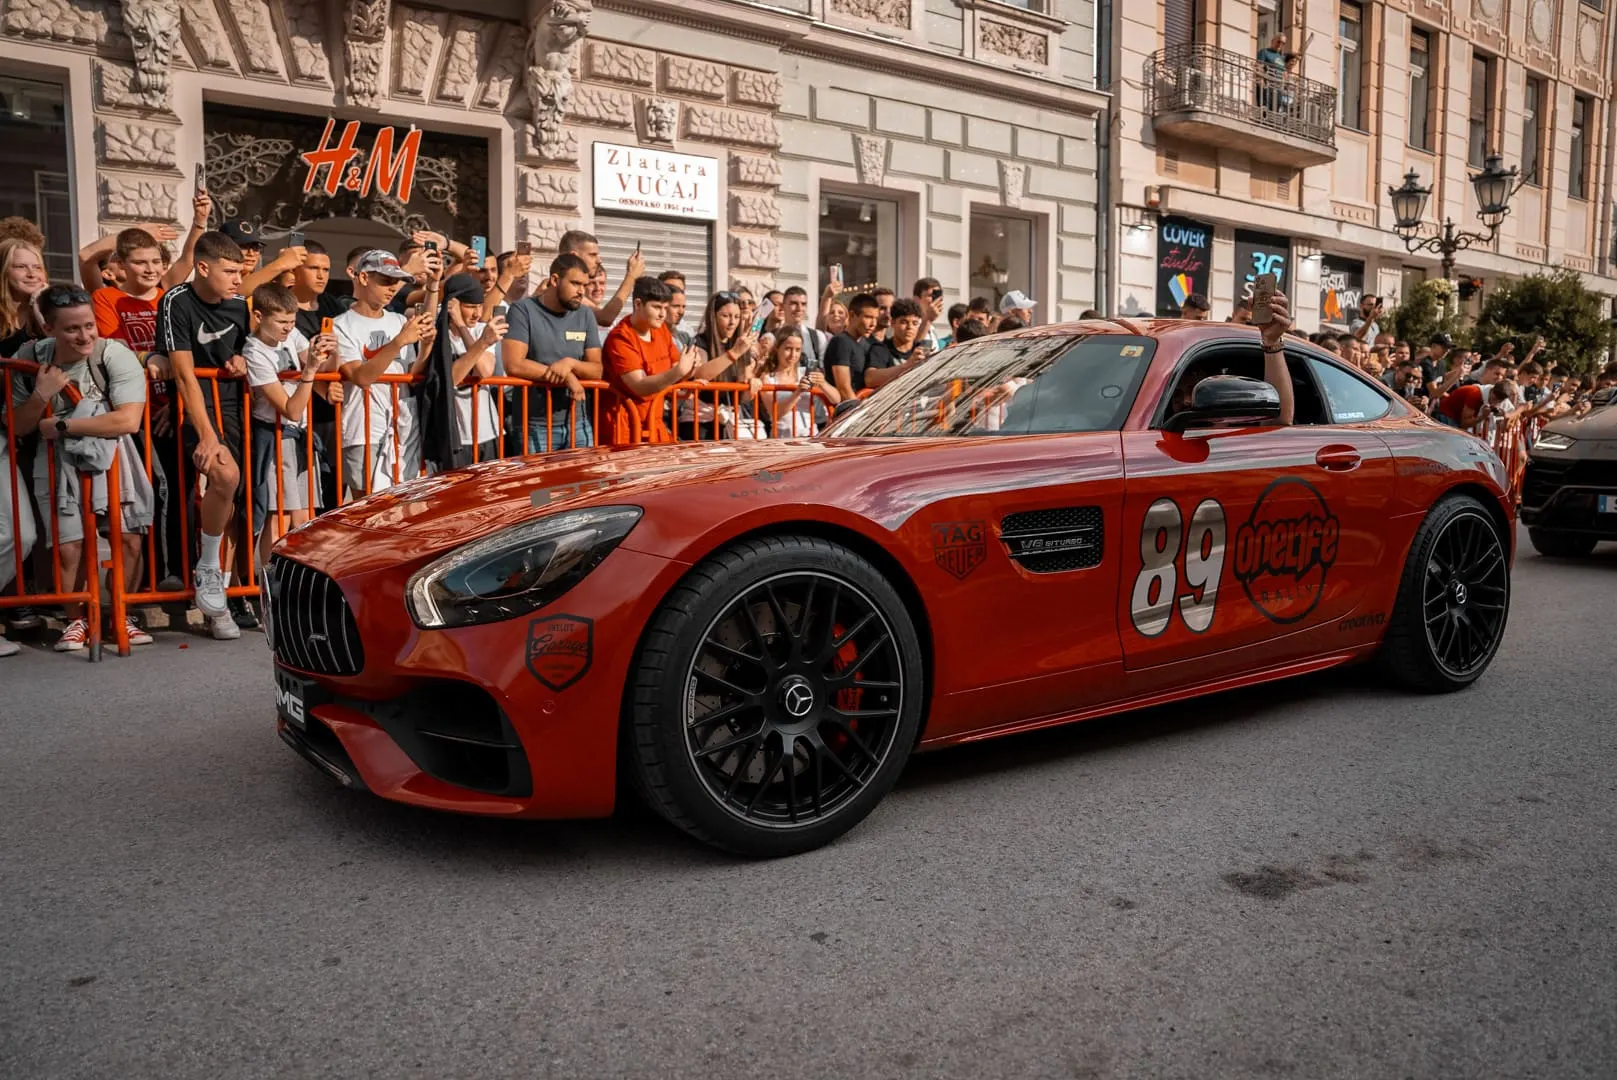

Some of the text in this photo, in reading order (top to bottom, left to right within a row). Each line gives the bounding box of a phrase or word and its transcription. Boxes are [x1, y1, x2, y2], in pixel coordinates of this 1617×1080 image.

[301, 118, 422, 204] H&M
[607, 148, 706, 176] Zlatara
[616, 173, 699, 200] VUČAJ
[1162, 224, 1206, 248] COVER
[1160, 247, 1203, 271] studio
[1245, 252, 1284, 283] 3G
[1320, 274, 1346, 294] ASTA
[936, 525, 981, 545] TAG
[935, 547, 984, 576] HEUER
[1131, 497, 1228, 638] 89
